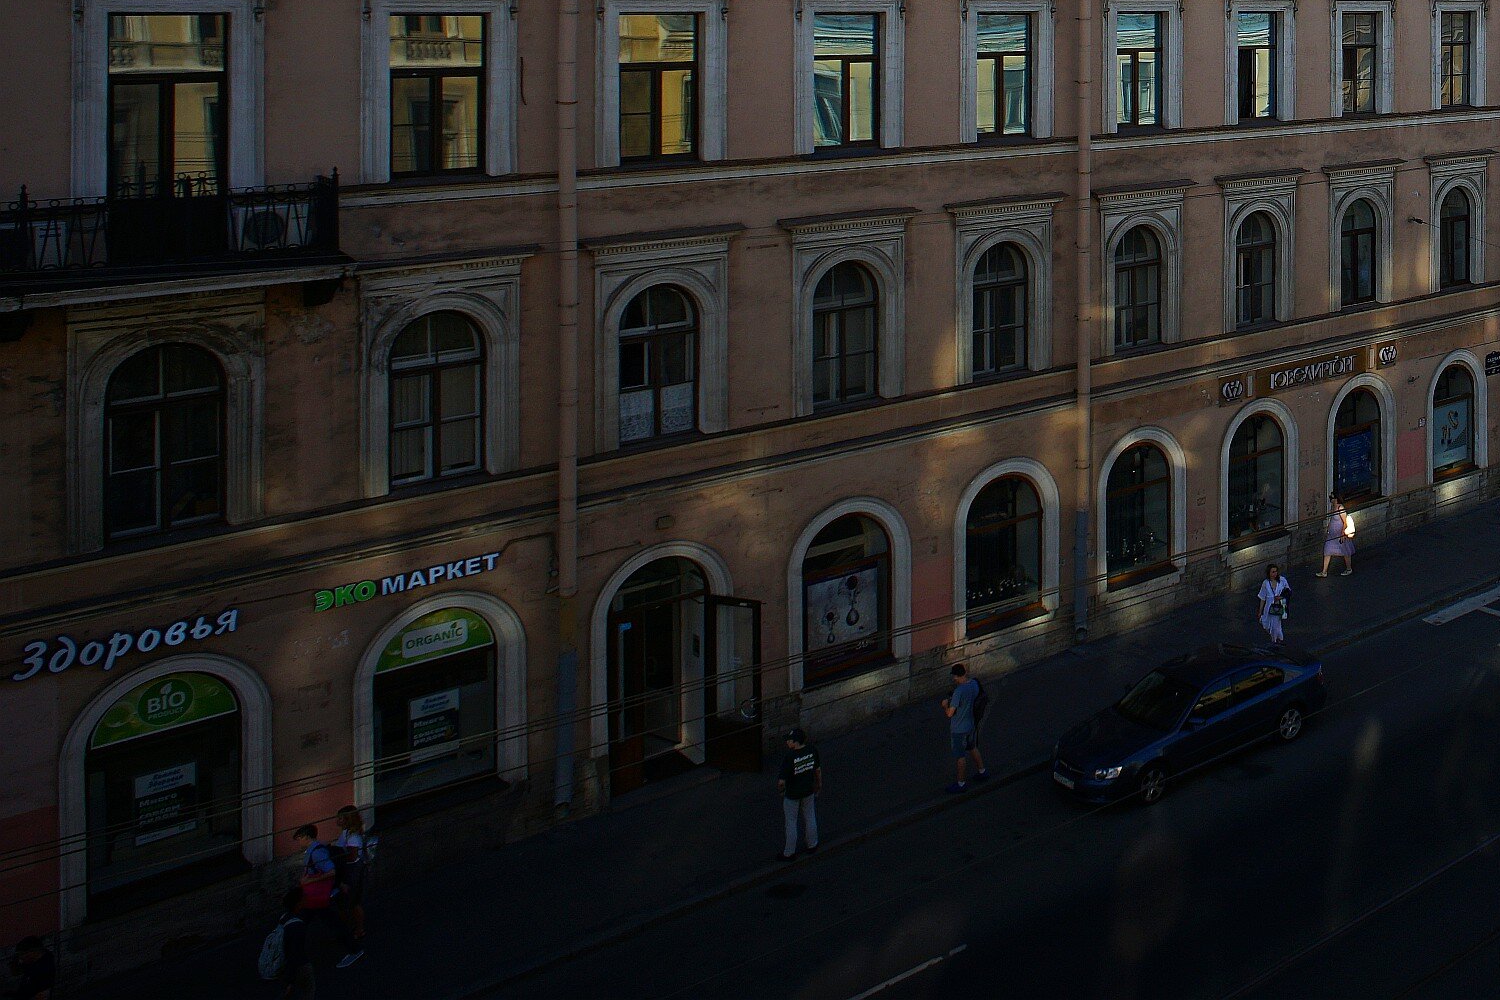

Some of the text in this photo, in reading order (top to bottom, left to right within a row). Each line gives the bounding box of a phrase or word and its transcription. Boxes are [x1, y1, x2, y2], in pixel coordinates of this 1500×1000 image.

[1270, 354, 1357, 390] ЮВЕЛИРТОРГ
[314, 552, 501, 613] ЭКО МАРКЕТ
[11, 608, 240, 682] Здоровья
[405, 627, 463, 650] ORGANIC
